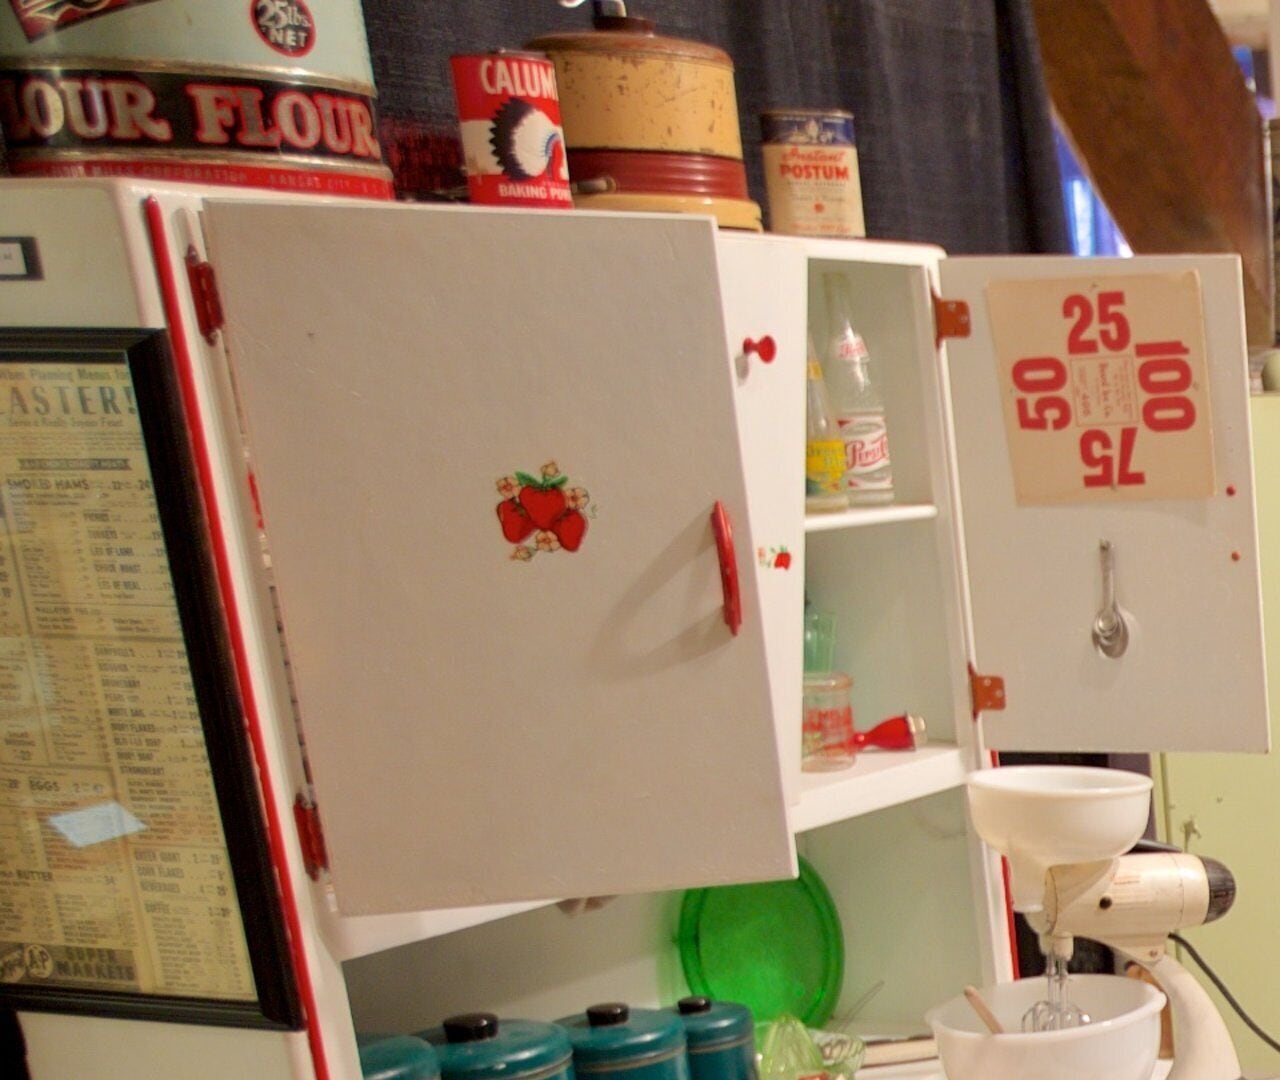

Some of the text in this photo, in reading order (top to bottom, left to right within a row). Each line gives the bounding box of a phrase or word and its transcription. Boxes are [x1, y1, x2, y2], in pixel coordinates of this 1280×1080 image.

[269, 26, 309, 47] NET
[185, 83, 382, 160] FLOUR
[779, 164, 850, 182] POSTUM
[499, 183, 547, 198] BAKING
[1062, 291, 1131, 355] 25
[0, 386, 136, 415] ASTER!
[1012, 356, 1072, 431] 50
[1135, 340, 1196, 432] 100
[1079, 427, 1146, 488] 75
[56, 479, 90, 490] HAMS
[29, 779, 61, 792] EGGS
